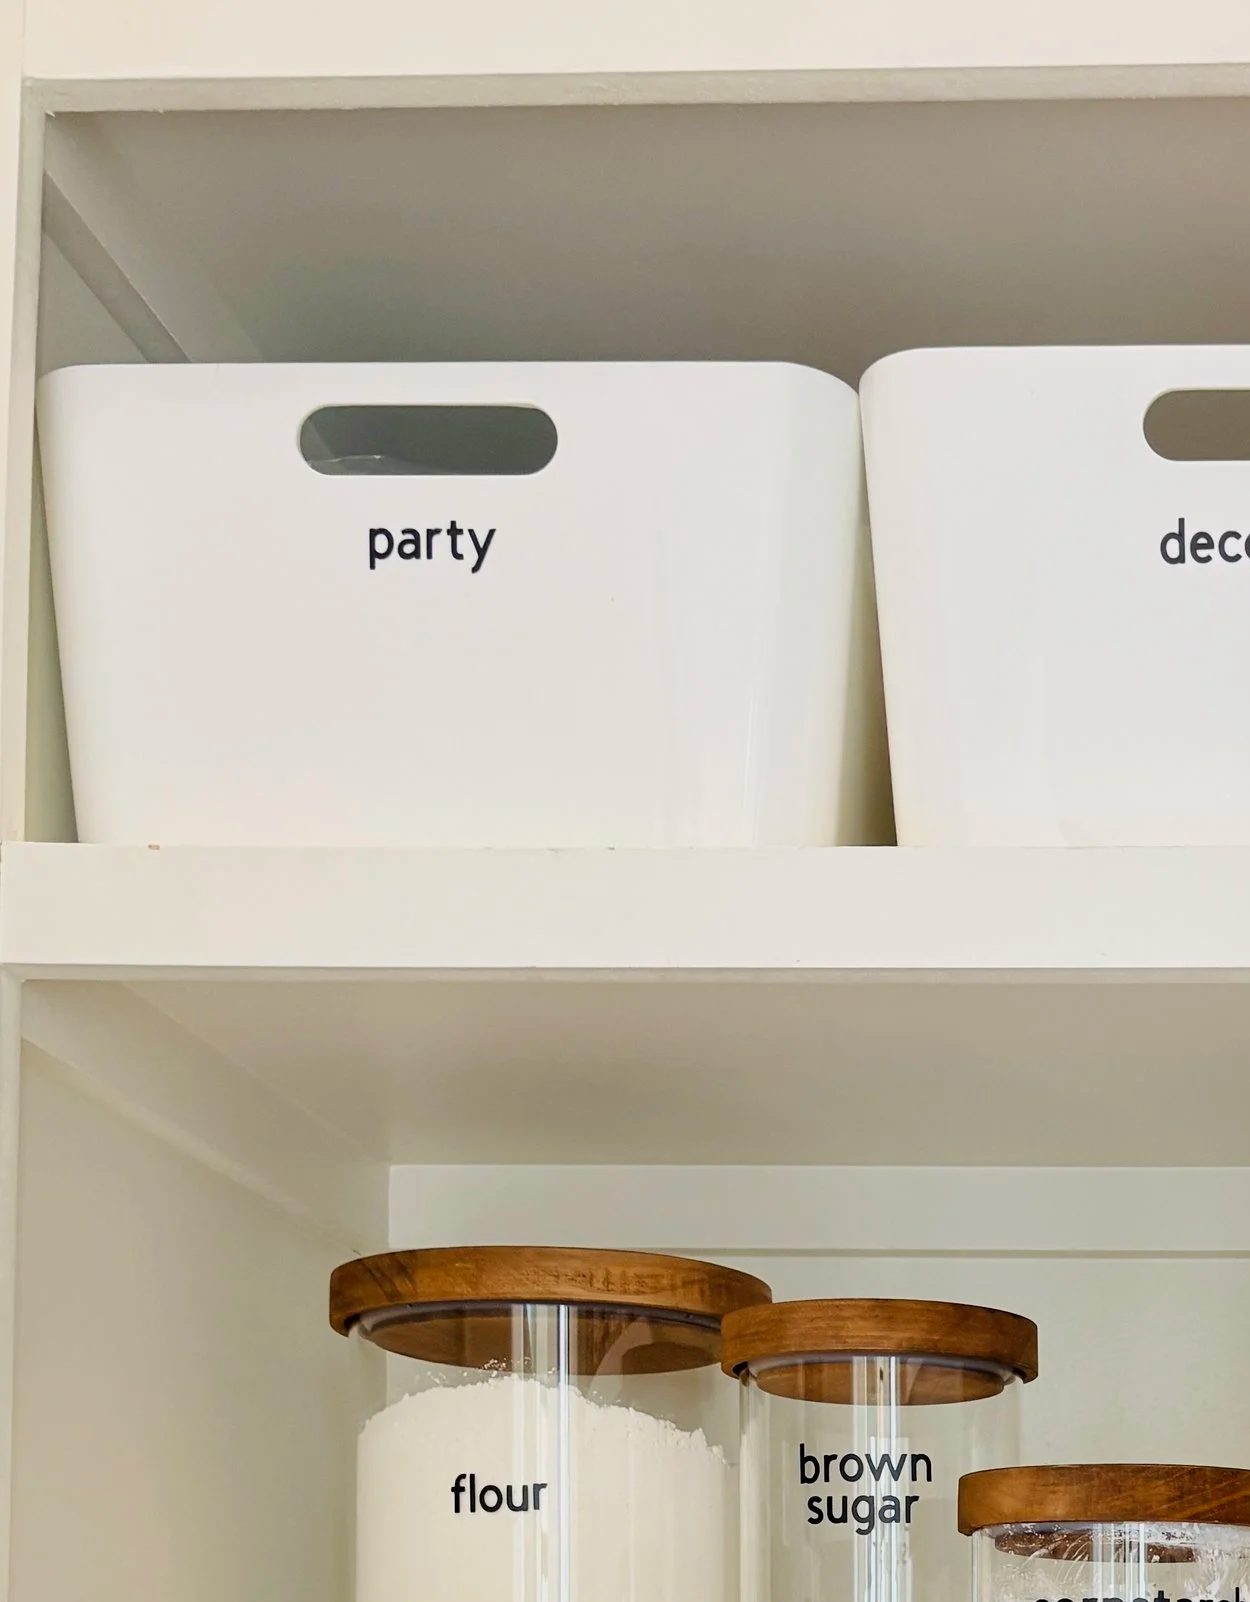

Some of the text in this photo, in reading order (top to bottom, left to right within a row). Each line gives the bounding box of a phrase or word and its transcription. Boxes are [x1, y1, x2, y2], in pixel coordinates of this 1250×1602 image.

[367, 519, 496, 571] party
[800, 1442, 932, 1486] brown
[451, 1473, 548, 1515] flour
[808, 1490, 920, 1535] sugar
